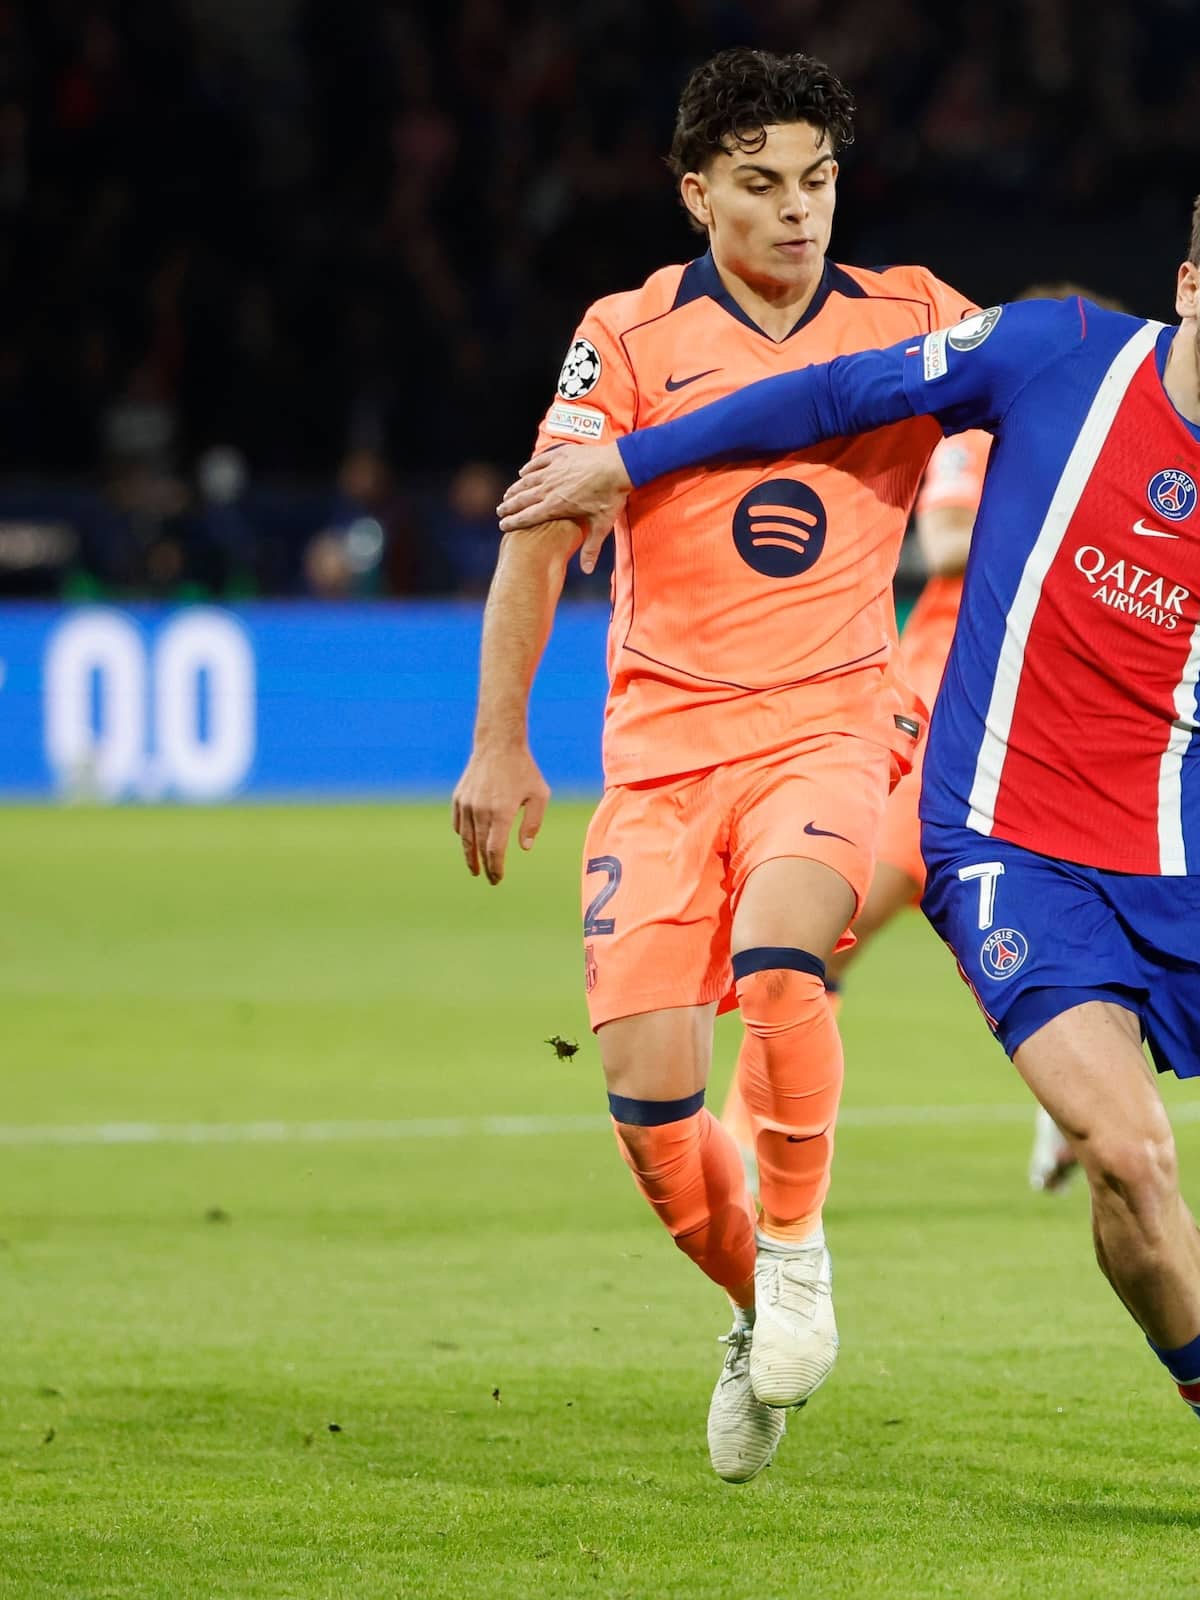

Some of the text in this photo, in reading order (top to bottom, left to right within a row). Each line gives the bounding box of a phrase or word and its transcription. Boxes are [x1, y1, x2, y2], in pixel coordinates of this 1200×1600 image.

[1163, 472, 1194, 493] PARIS
[1074, 545, 1190, 615] QATAR
[1091, 585, 1180, 630] AIRWAYS
[958, 861, 1006, 931] 7
[984, 930, 1014, 952] PARIS
